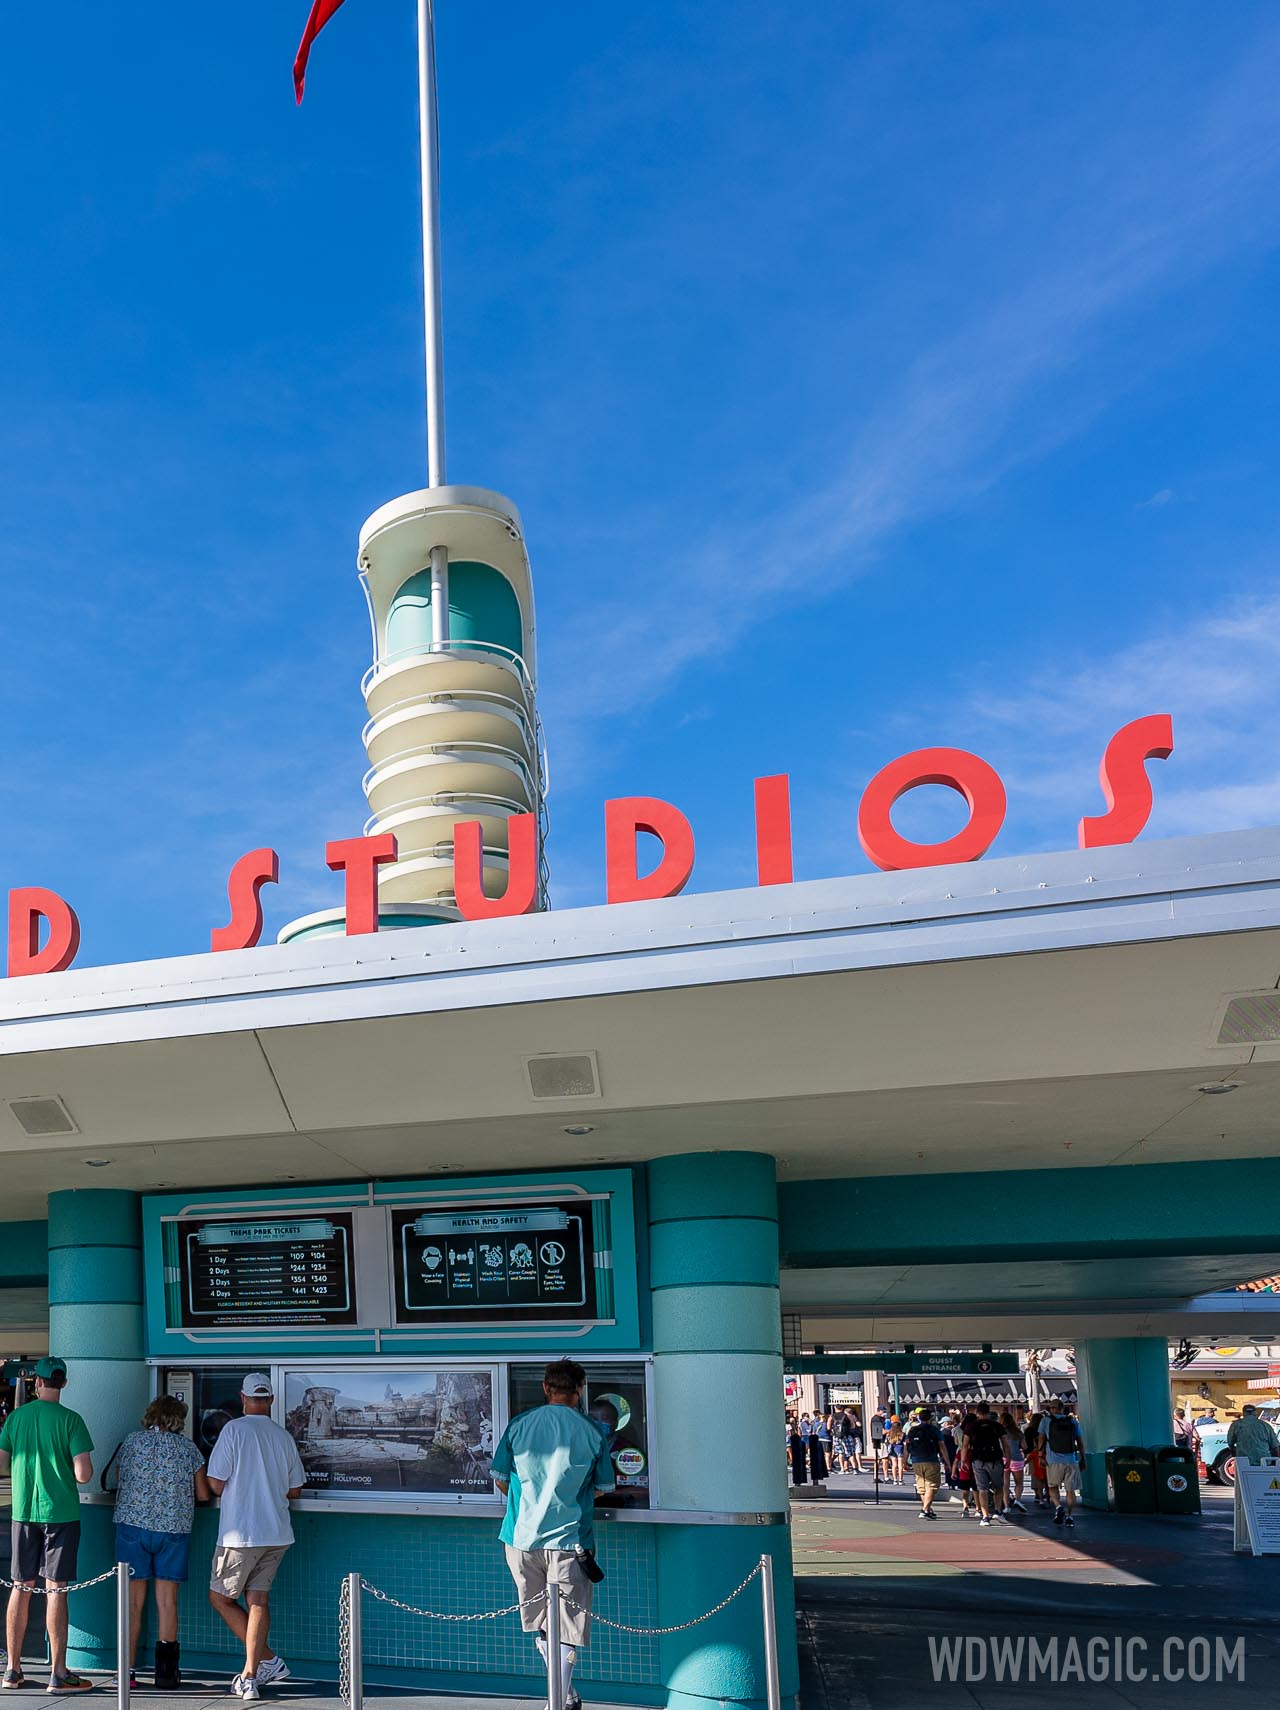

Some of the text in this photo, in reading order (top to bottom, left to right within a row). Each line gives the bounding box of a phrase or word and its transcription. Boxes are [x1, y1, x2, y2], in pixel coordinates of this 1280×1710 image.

[210, 713, 1175, 953] STUDIOS
[452, 1219, 480, 1227] HEALTH
[500, 1217, 528, 1225] SAFETY
[230, 1229, 251, 1237] THEME
[215, 1256, 227, 1264] Day
[215, 1267, 230, 1276] Days
[290, 1264, 306, 1272] $244
[215, 1278, 231, 1287] Days
[216, 1290, 231, 1298] Days
[312, 1286, 328, 1294] $423
